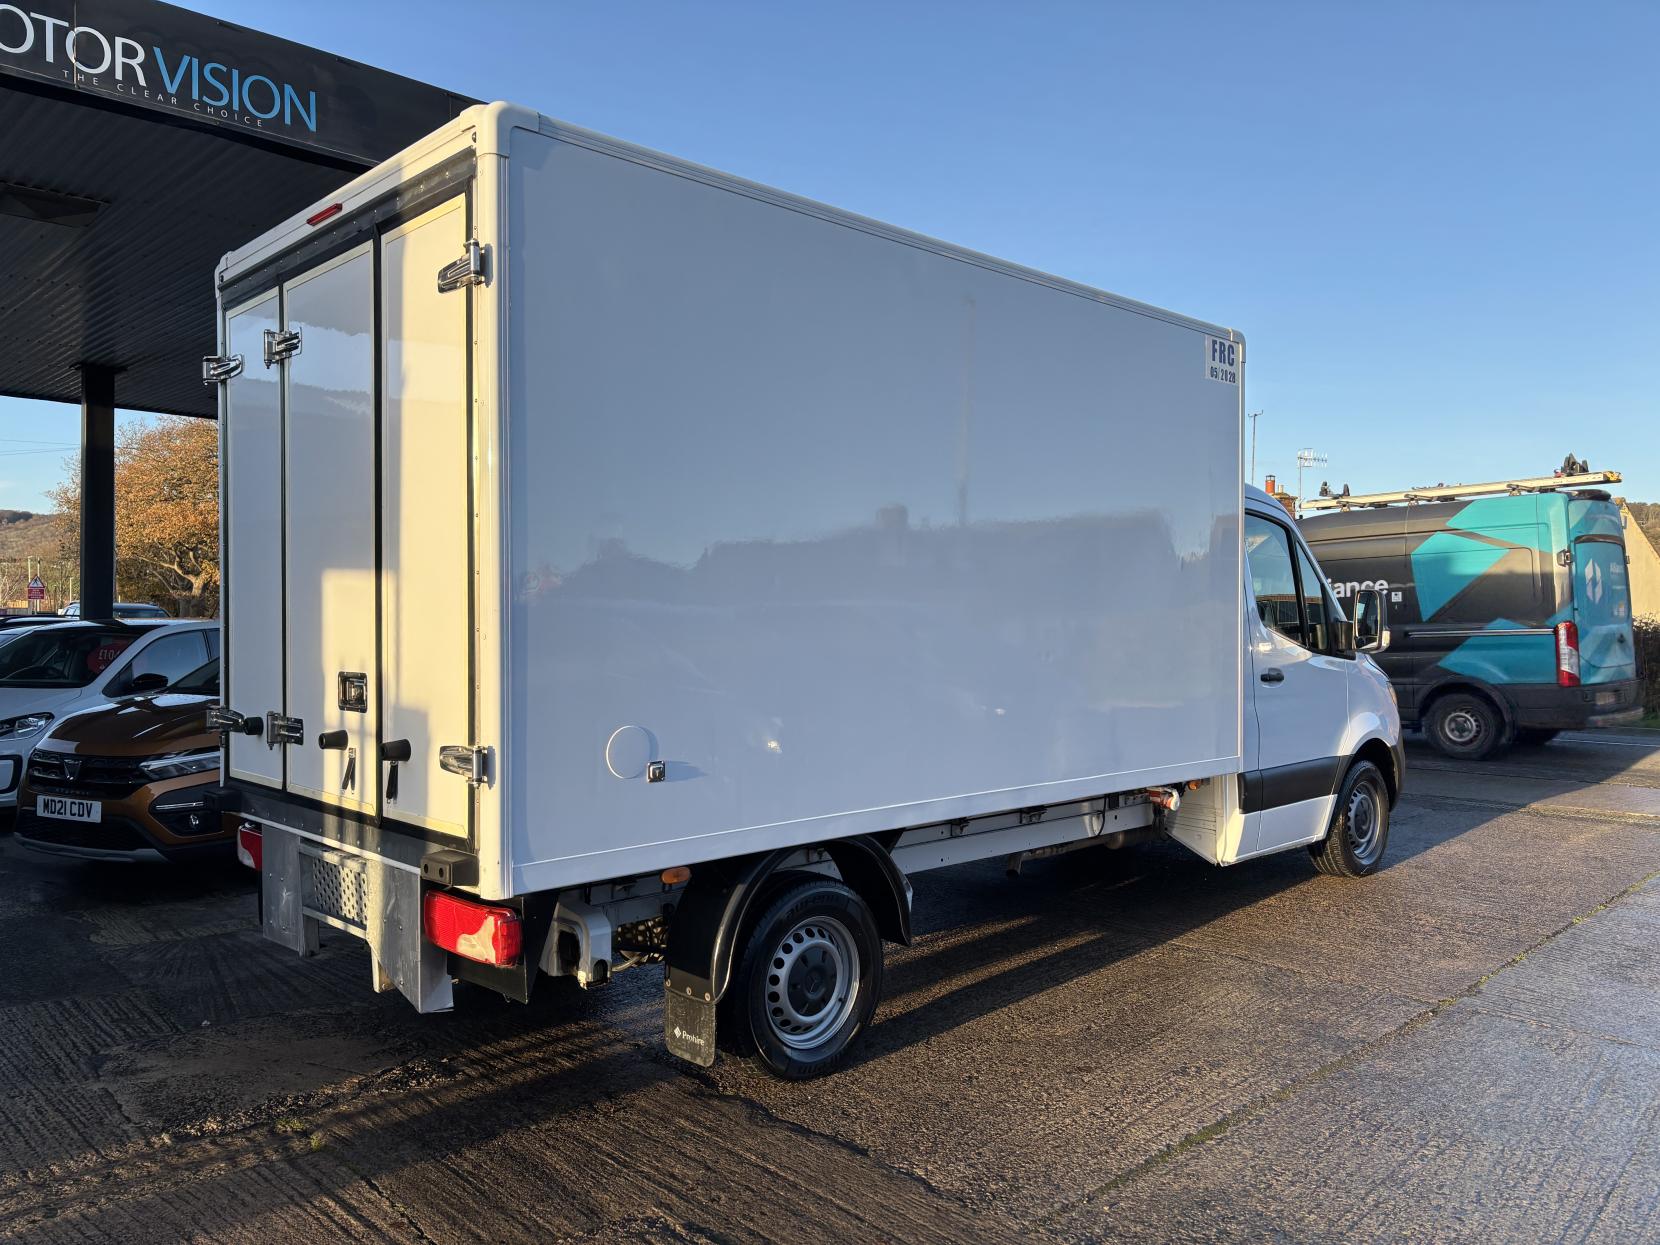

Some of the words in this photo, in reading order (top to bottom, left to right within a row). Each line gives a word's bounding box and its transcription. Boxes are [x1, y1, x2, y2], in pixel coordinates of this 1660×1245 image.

[61, 69, 99, 86] THE
[117, 83, 177, 105] CLEAR
[194, 103, 263, 127] CHOICE
[153, 46, 317, 132] VISION
[1211, 339, 1235, 367] FRC
[43, 797, 67, 816] MD21
[69, 800, 93, 819] CDV
